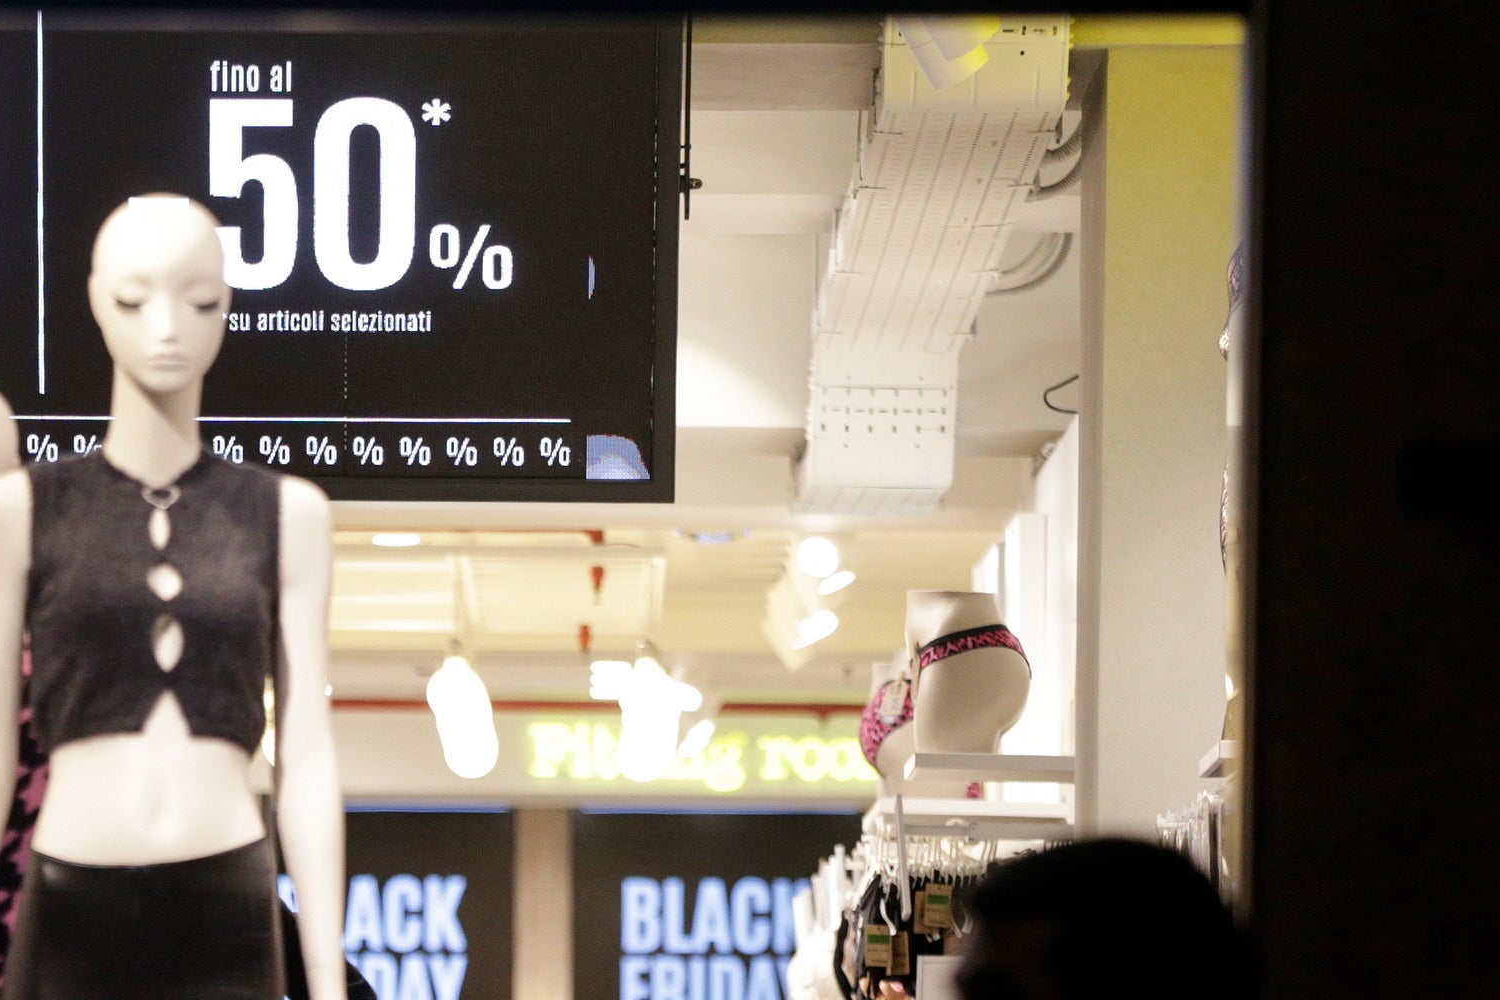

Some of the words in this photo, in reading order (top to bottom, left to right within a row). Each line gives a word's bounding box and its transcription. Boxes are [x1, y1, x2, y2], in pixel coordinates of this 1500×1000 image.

[210, 61, 260, 93] fino
[270, 61, 292, 93] al
[257, 309, 325, 333] articoli
[331, 309, 432, 333] selezionati
[26, 433, 59, 463] %
[212, 435, 244, 465] %
[259, 435, 291, 465] %
[306, 436, 337, 466] %
[352, 436, 384, 466] %
[399, 436, 431, 466] %
[446, 436, 478, 467] %
[493, 436, 525, 467] %
[540, 436, 572, 467] %
[277, 873, 468, 954] ACK
